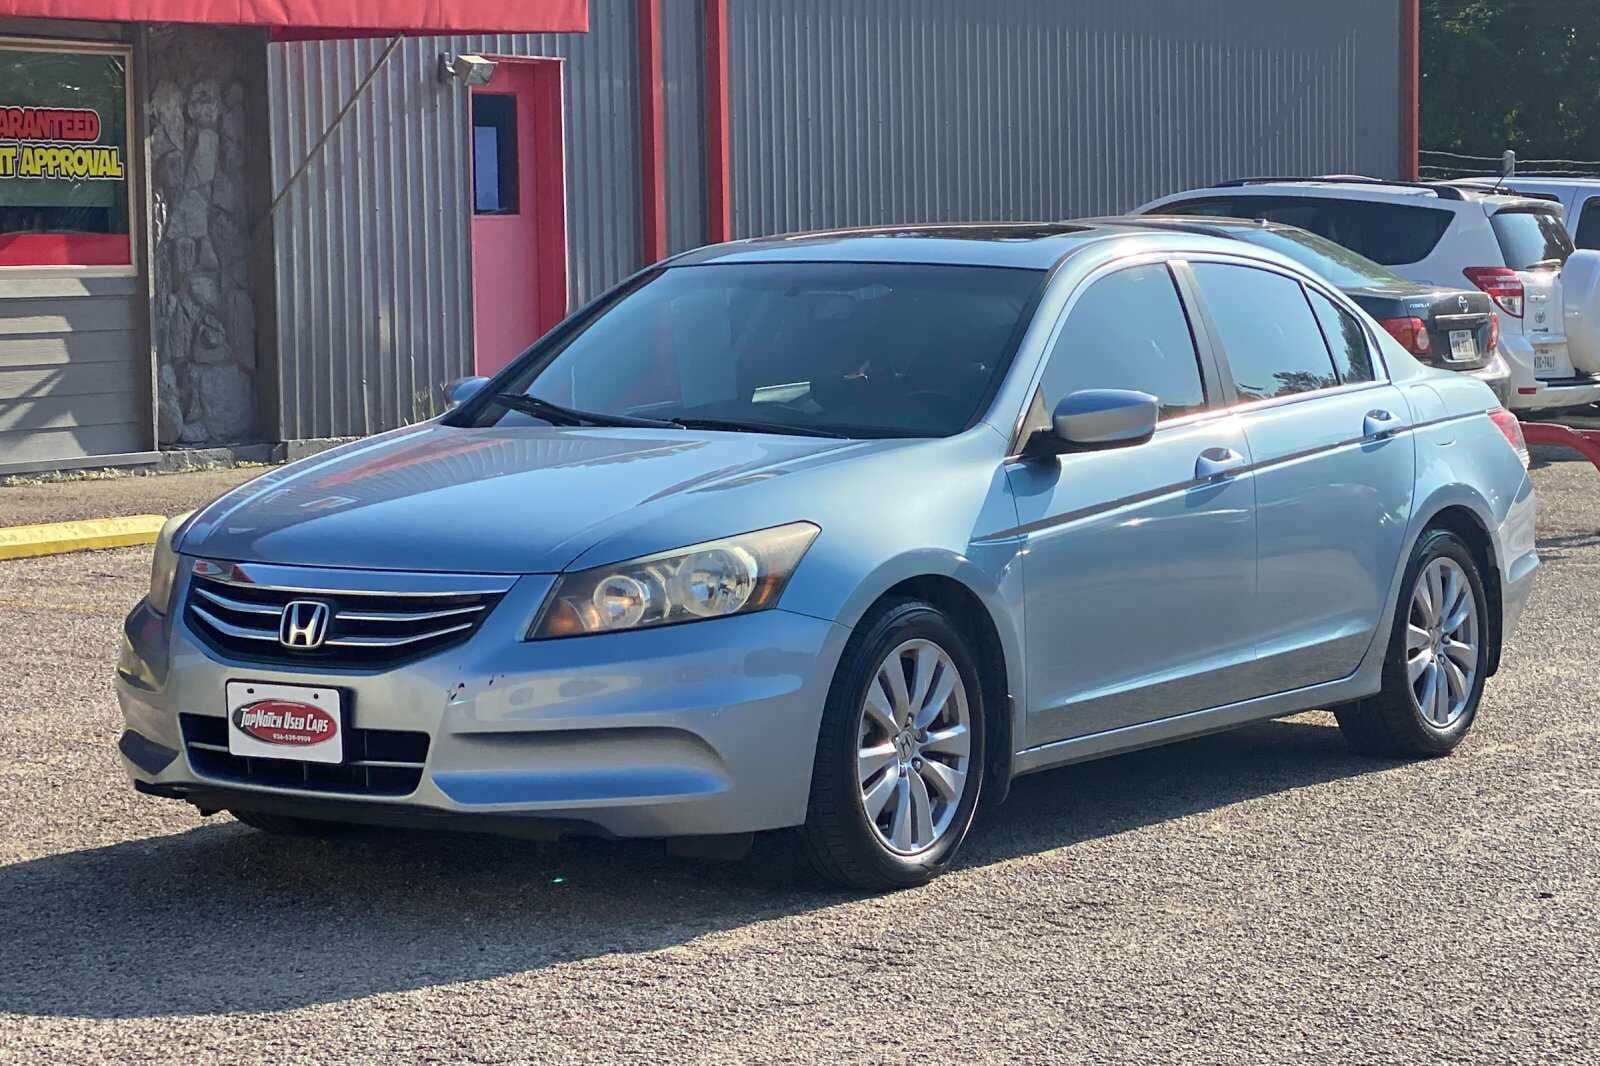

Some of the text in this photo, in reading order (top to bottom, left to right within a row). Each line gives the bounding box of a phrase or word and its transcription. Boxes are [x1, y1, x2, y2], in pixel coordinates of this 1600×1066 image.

[20, 147, 122, 178] APPROVAL
[283, 711, 304, 730] USED
[306, 713, 329, 733] CARS
